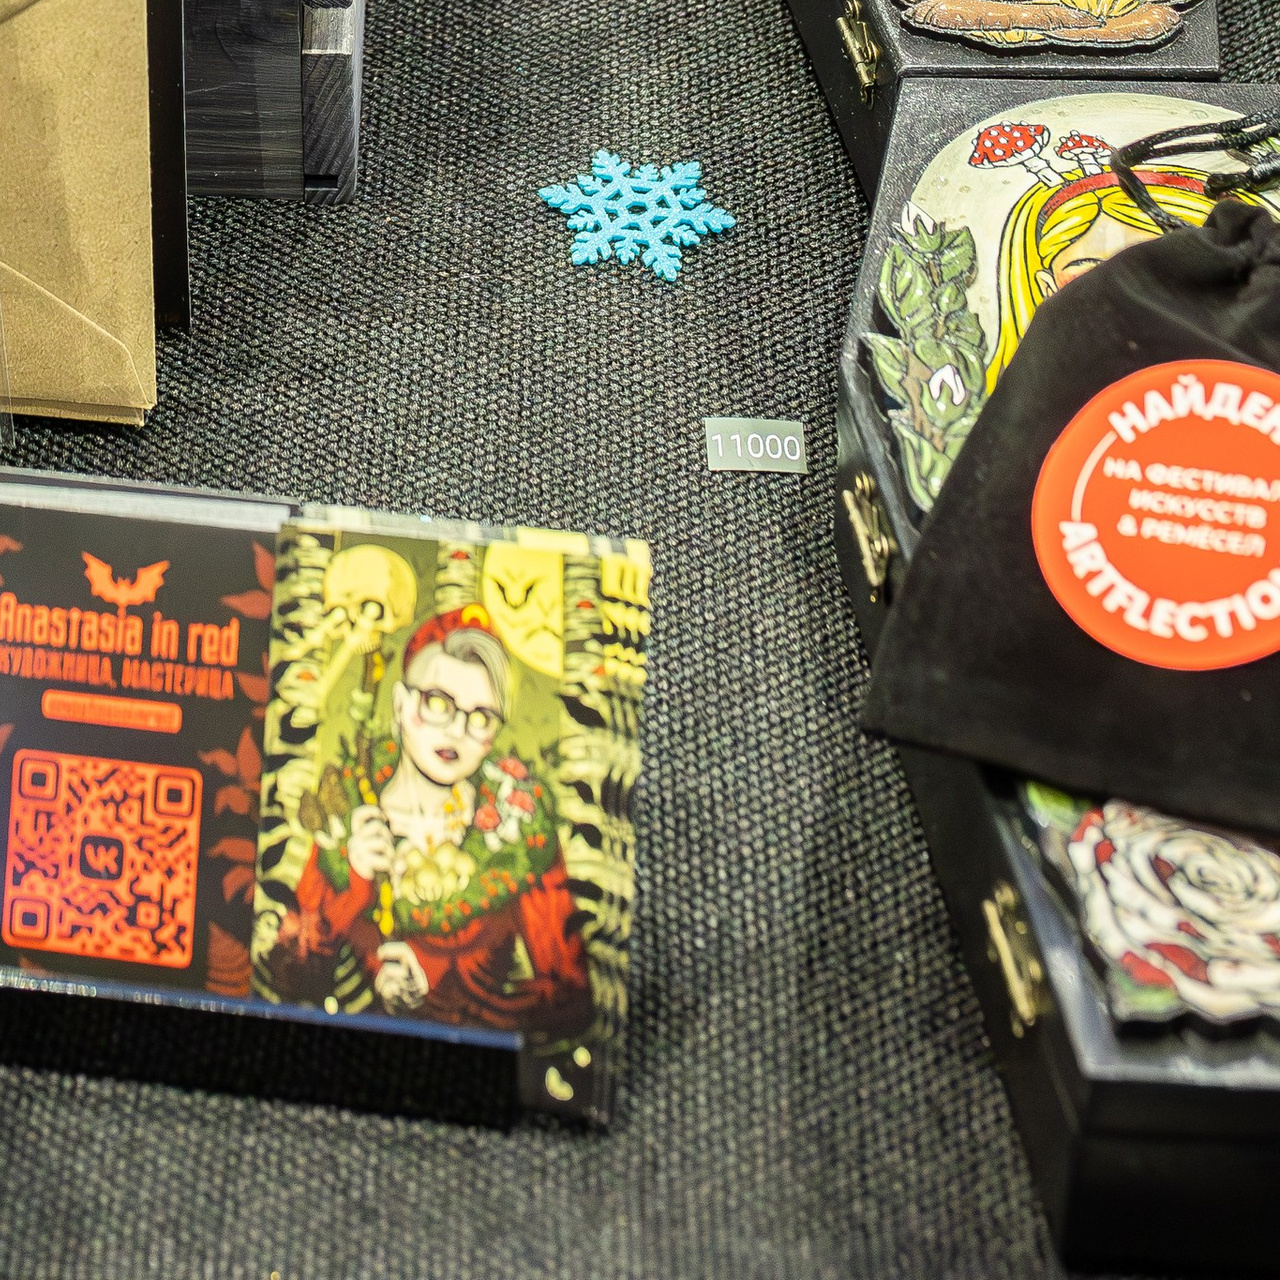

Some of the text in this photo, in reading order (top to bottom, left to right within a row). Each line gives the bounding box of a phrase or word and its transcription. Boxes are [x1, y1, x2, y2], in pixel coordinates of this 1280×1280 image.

[711, 432, 801, 461] 11000
[1102, 456, 1142, 482] НА
[1116, 514, 1138, 537] &
[1128, 487, 1267, 530] ИСКУССТВ
[1059, 521, 1280, 642] ARTFLECTIO
[150, 610, 180, 661] in
[187, 616, 240, 667] red
